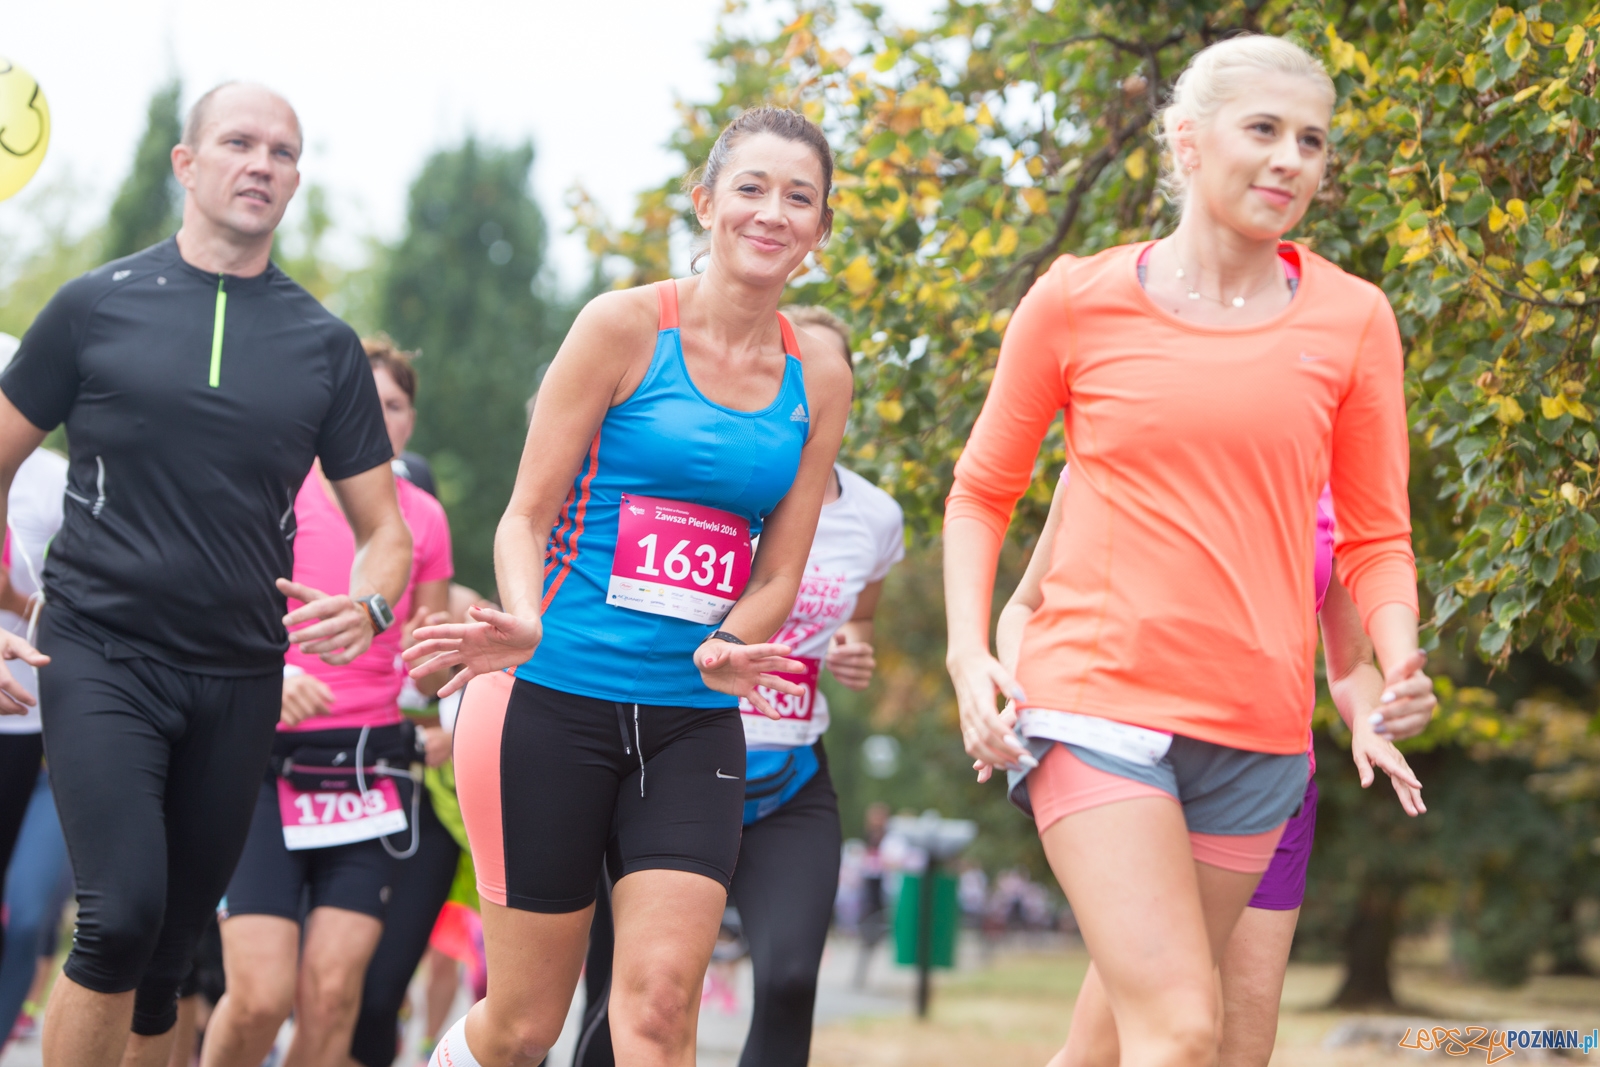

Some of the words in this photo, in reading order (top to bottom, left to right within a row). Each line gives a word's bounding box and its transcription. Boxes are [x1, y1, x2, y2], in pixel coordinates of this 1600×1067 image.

[655, 510, 687, 525] Zawsze
[688, 516, 720, 532] Pier(w)si
[720, 524, 738, 537] 2016
[635, 533, 736, 594] 1631
[294, 788, 388, 825] 1703
